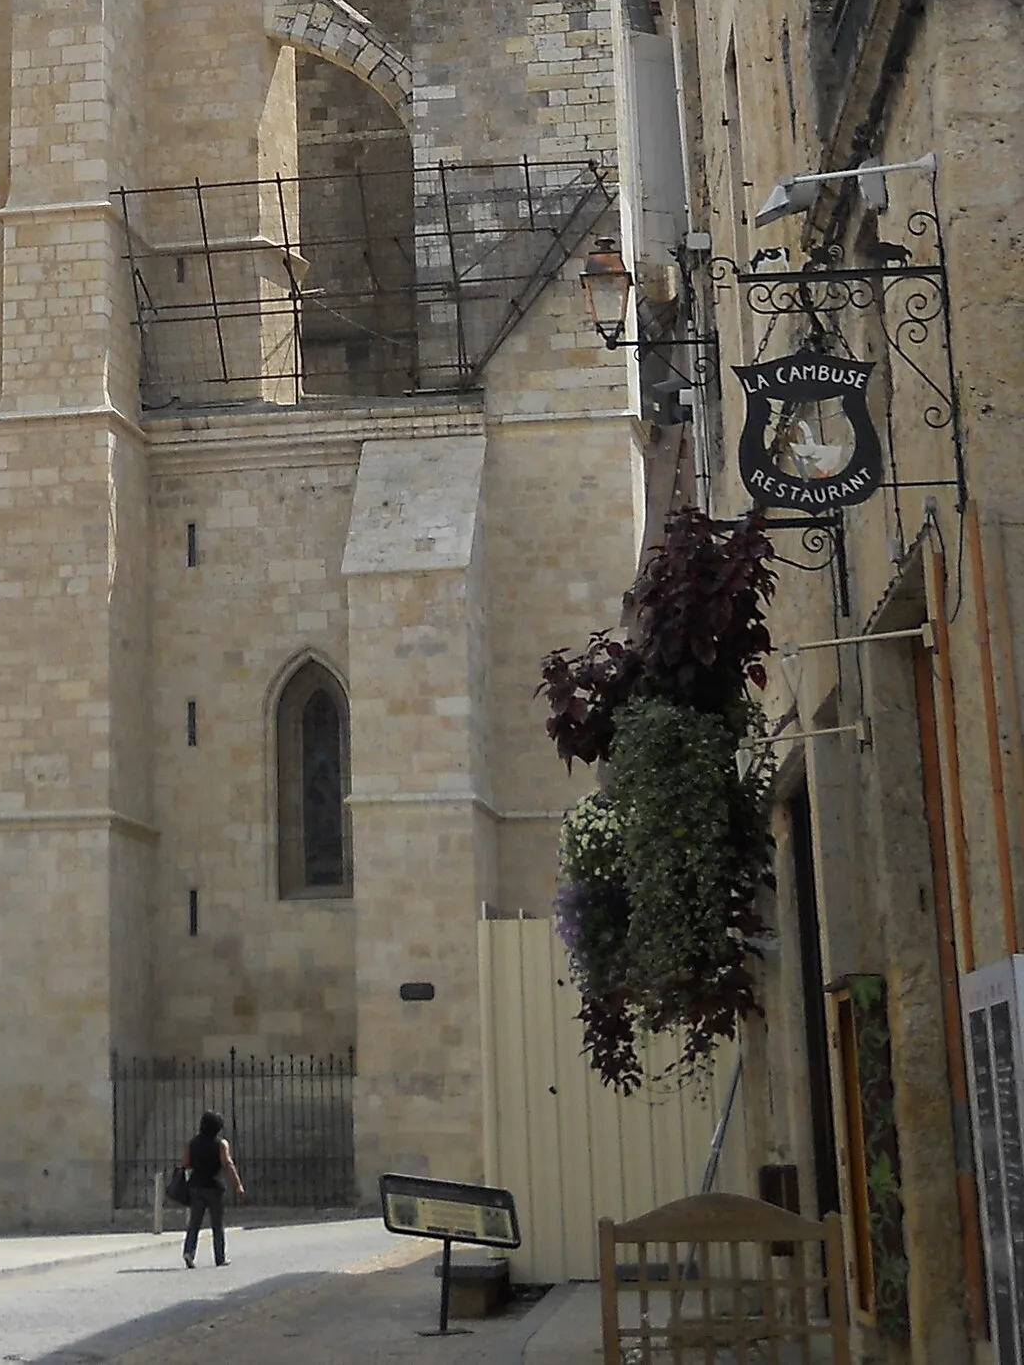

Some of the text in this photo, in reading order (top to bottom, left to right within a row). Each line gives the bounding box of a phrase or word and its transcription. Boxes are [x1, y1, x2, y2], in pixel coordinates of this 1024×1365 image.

[743, 365, 868, 394] LA CAMBUSE
[750, 467, 872, 504] RESTAURANT
